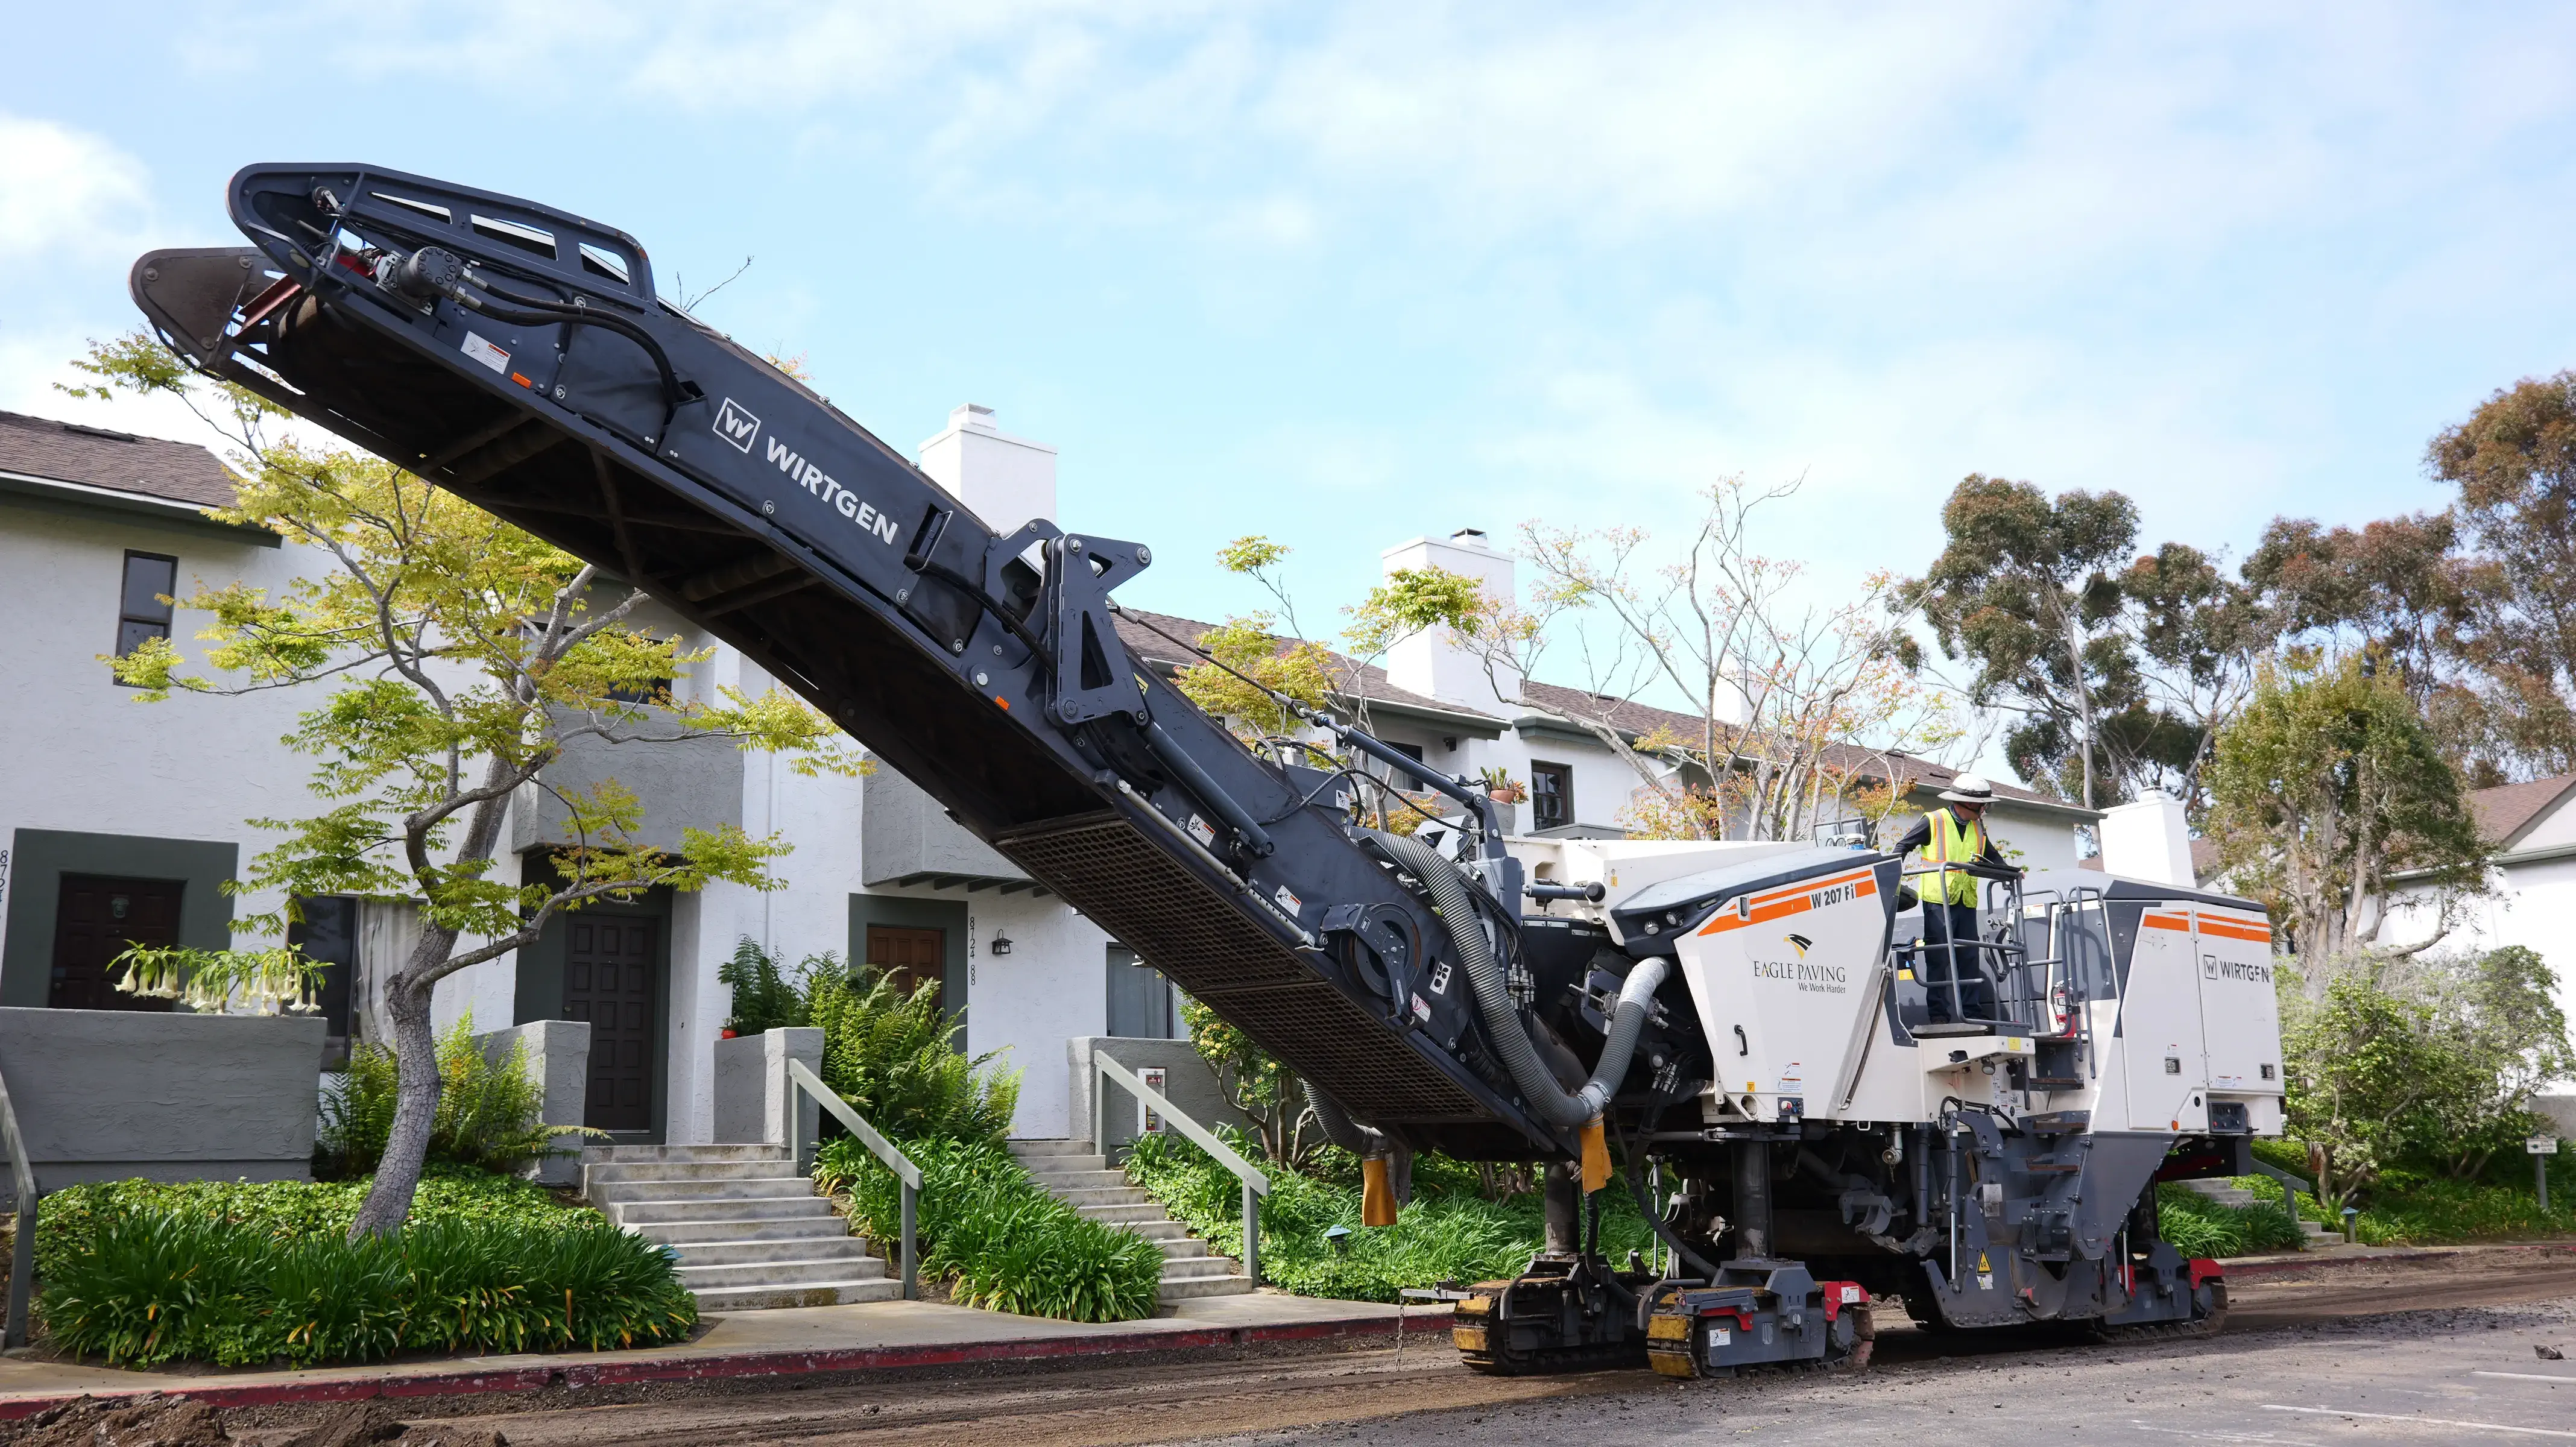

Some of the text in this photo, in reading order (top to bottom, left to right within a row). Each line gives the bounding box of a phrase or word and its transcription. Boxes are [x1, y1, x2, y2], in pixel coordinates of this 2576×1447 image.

[725, 407, 898, 545] W WIRTGEN
[1811, 883, 1854, 909] W 207 Fi
[970, 965, 976, 985] 88
[1753, 960, 1846, 983] EAGLE PAVING
[2206, 960, 2270, 983] W WIRTGEN
[1798, 982, 1846, 994] We Work Harder
